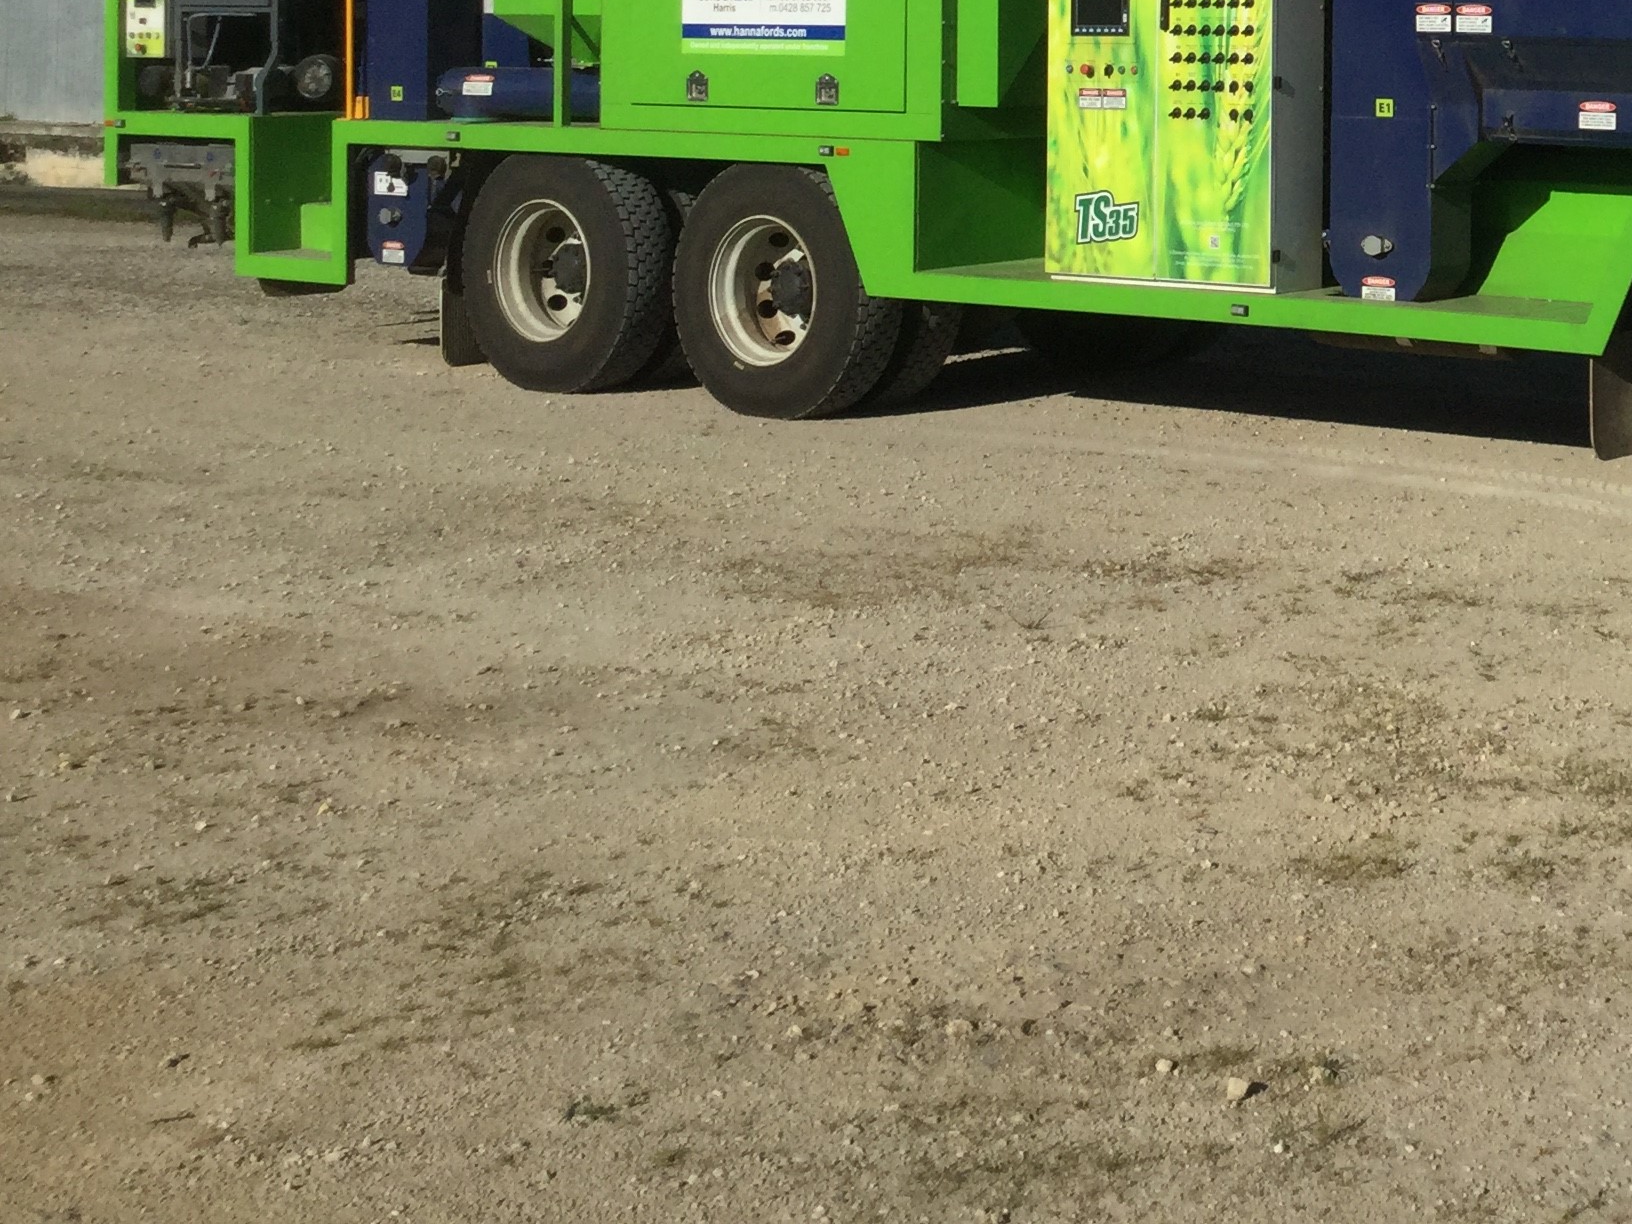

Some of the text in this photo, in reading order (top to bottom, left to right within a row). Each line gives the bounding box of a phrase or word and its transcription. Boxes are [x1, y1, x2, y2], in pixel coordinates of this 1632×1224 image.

[713, 3, 736, 13] Harris
[709, 26, 808, 38] www.hannafords.com
[1379, 102, 1391, 113] E1
[1076, 192, 1137, 242] TS35
